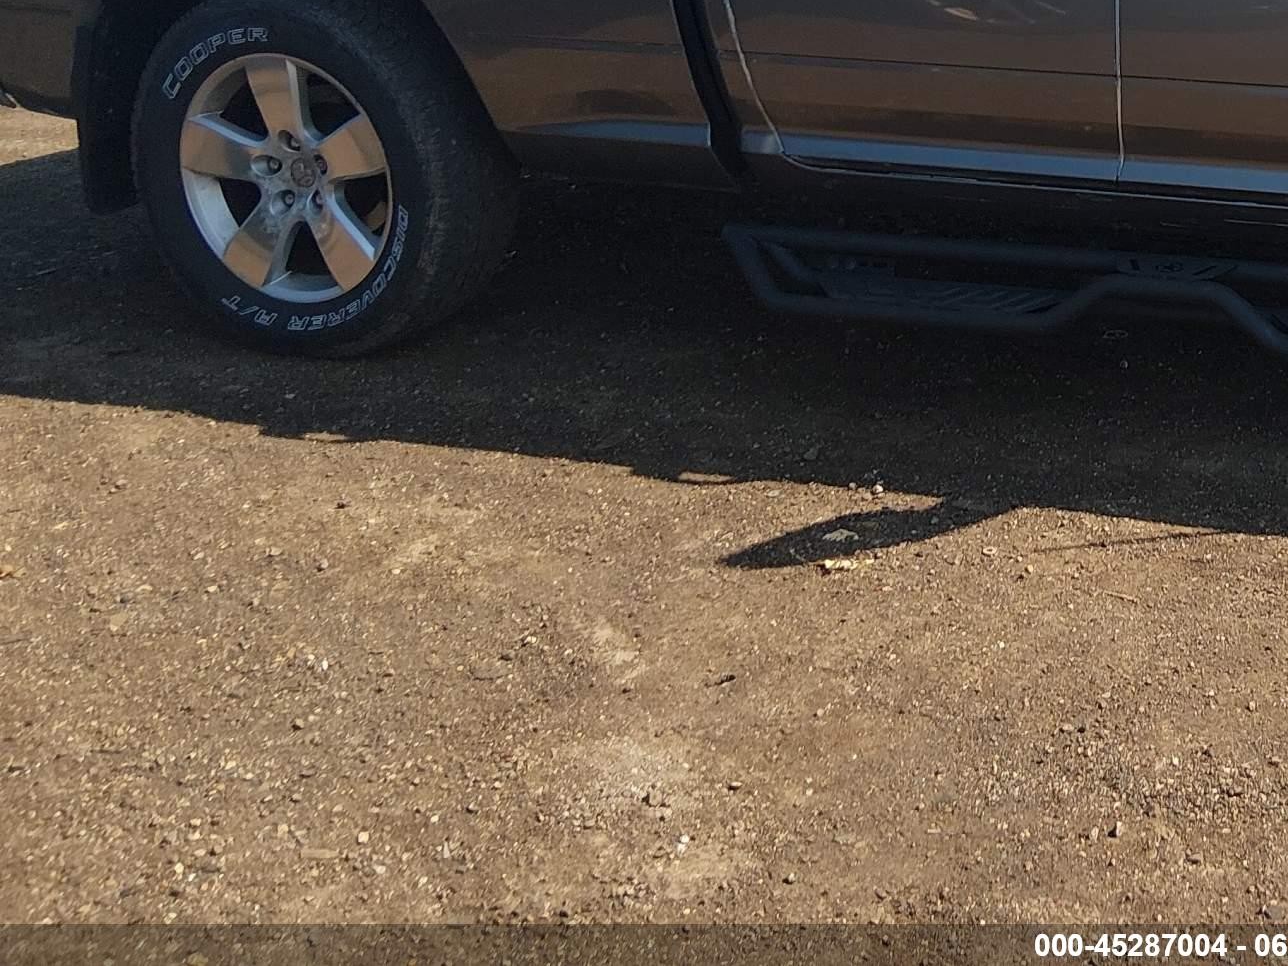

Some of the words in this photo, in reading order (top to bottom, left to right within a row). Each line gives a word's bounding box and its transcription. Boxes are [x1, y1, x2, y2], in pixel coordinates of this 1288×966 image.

[162, 27, 268, 99] COOPER
[287, 204, 409, 331] DISCOVERER
[221, 294, 278, 326] A/T
